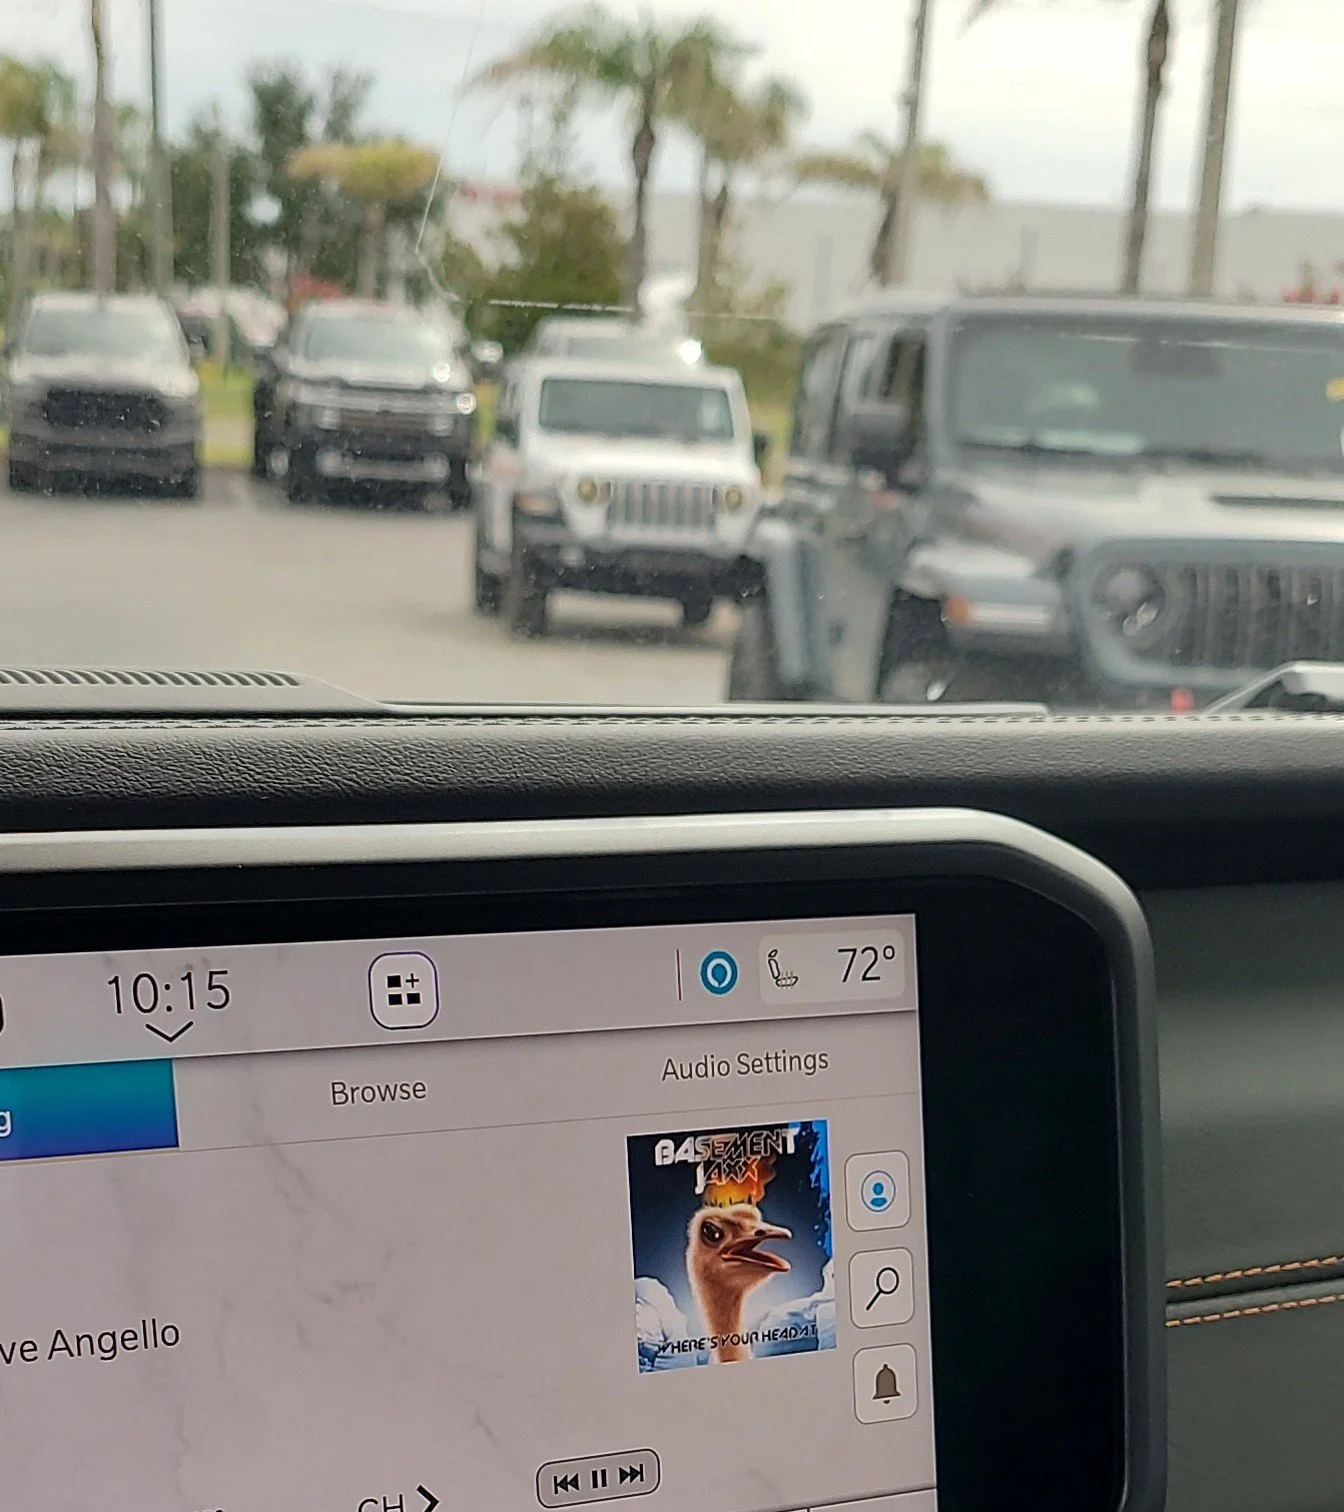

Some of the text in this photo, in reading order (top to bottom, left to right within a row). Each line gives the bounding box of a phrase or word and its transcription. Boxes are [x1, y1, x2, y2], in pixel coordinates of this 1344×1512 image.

[837, 945, 896, 985] 72°
[108, 970, 232, 1015] 10:15
[661, 1048, 830, 1083] Audio Settings
[330, 1076, 429, 1106] Browse
[655, 1127, 800, 1166] BASEMENT
[695, 1155, 763, 1196] JAXX
[47, 1318, 182, 1367] Angello
[720, 1332, 760, 1348] YOUR
[762, 1327, 798, 1343] HEAD
[798, 1323, 818, 1339] AT
